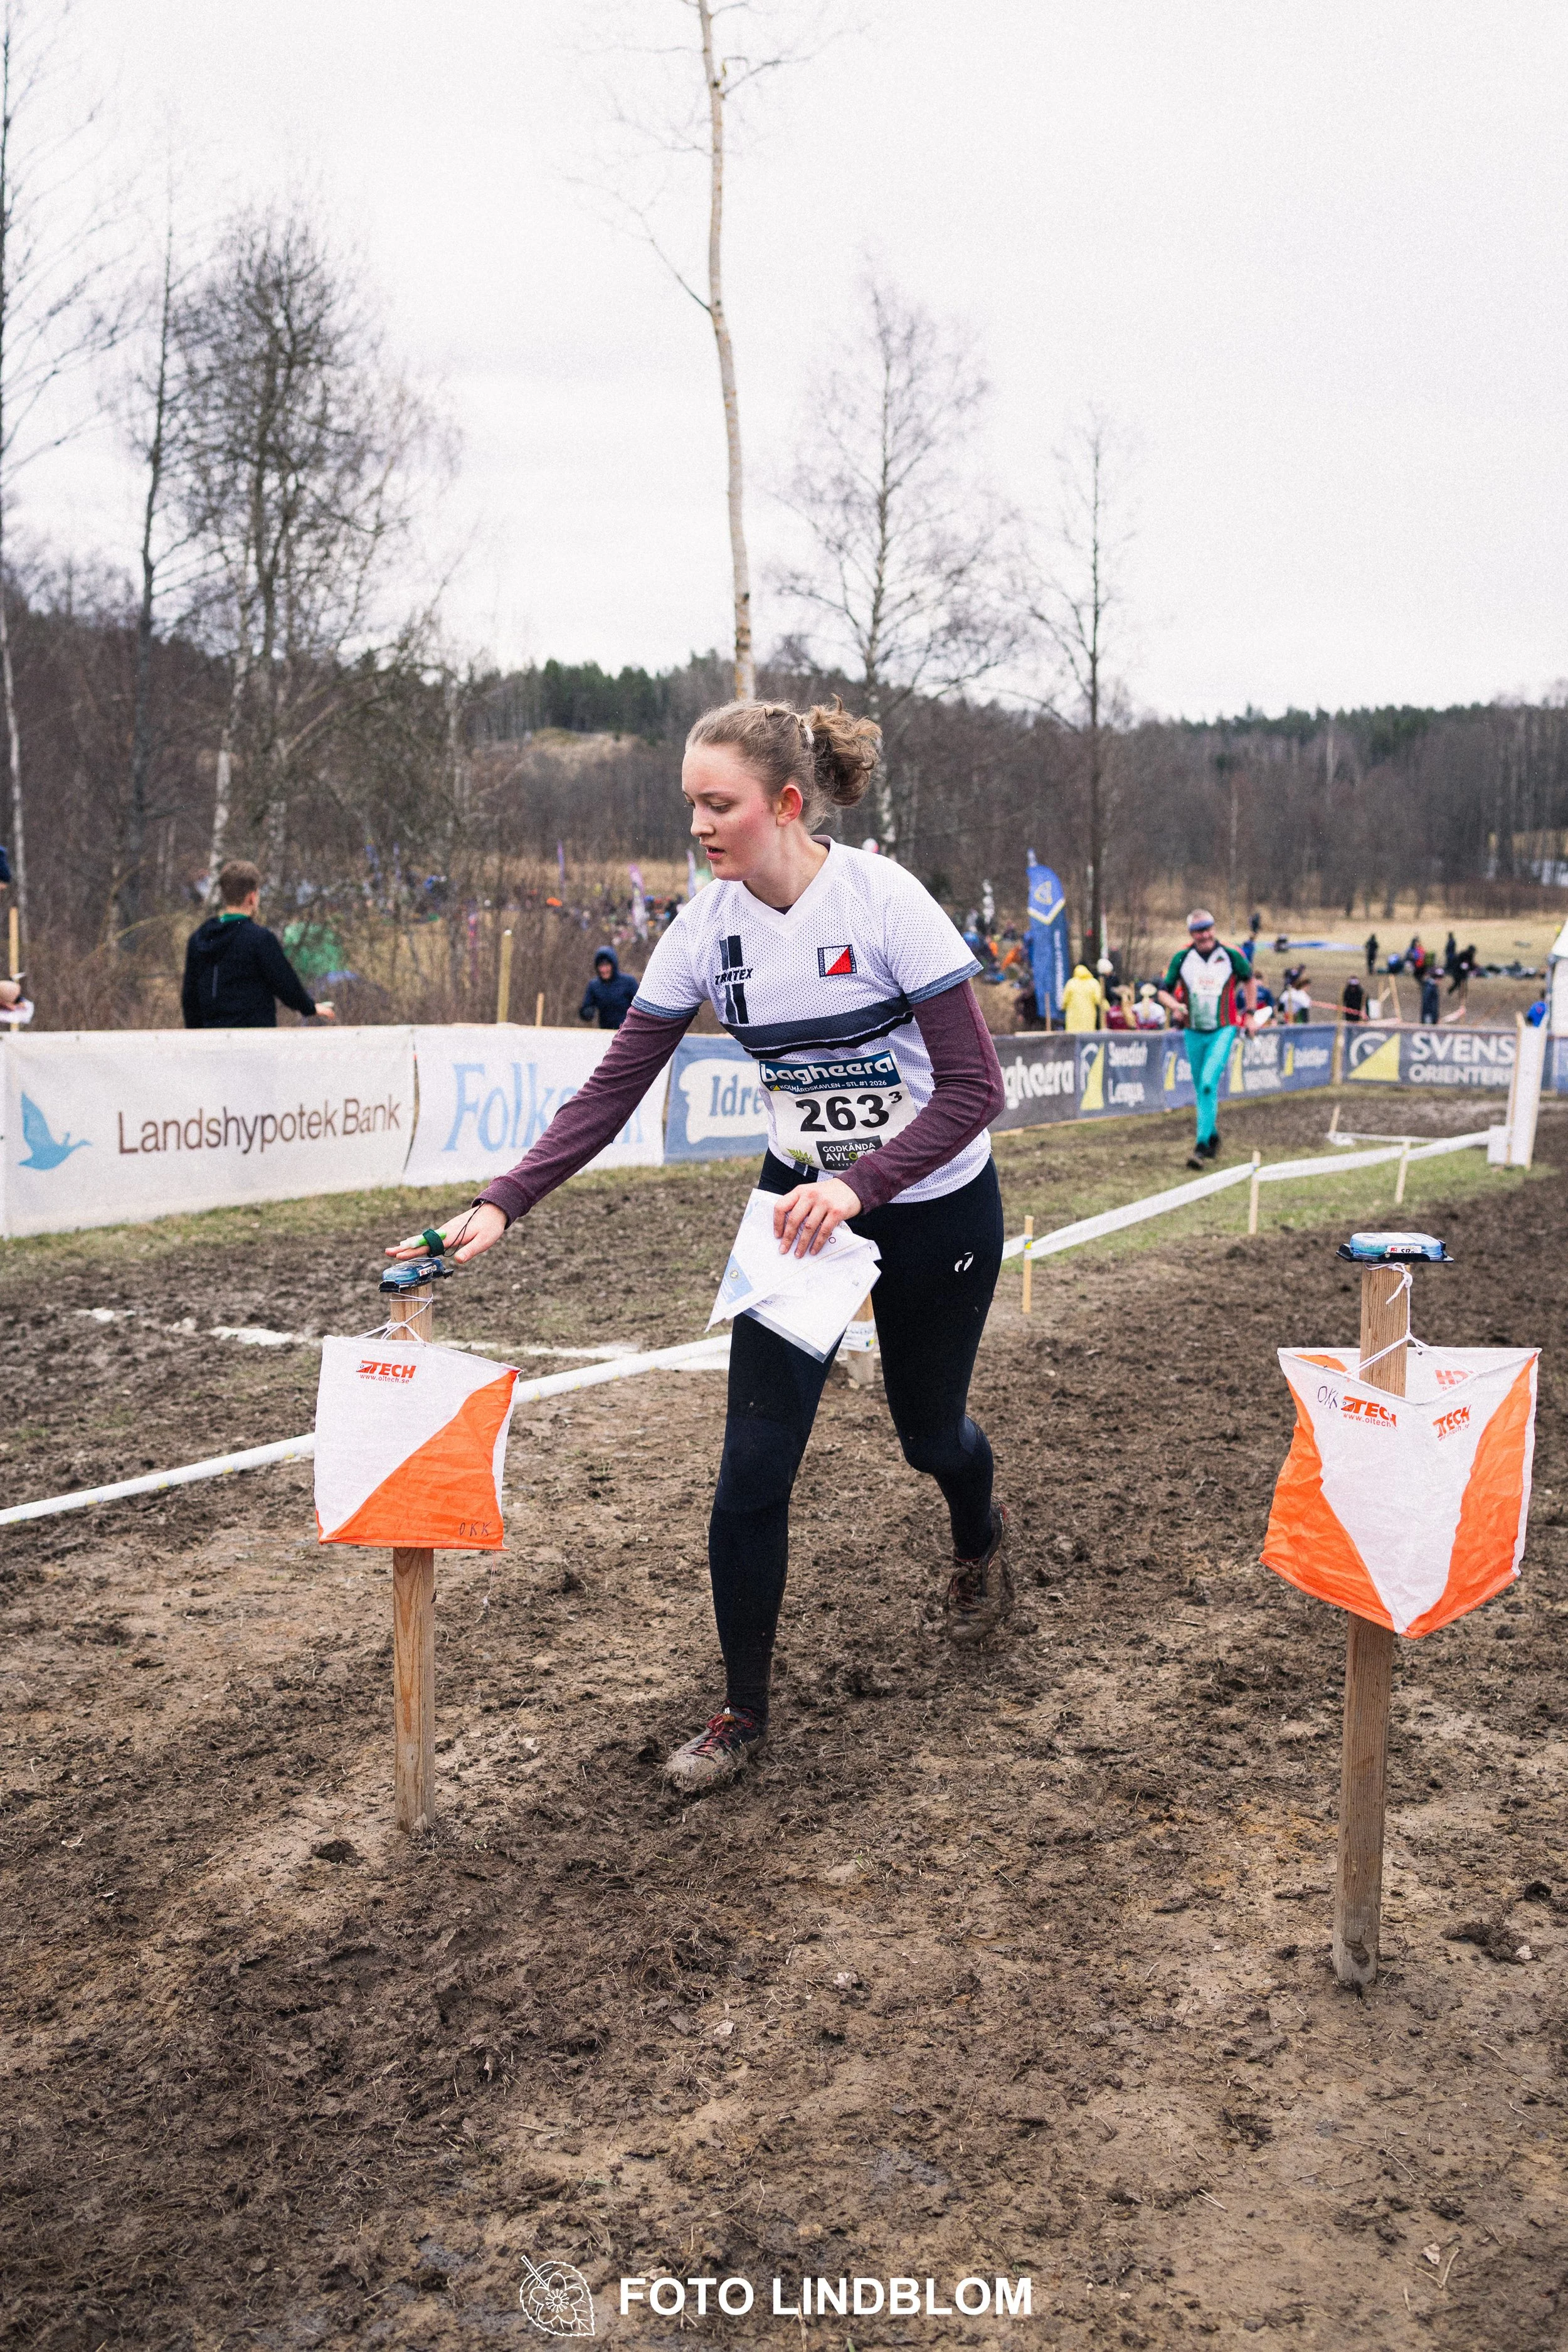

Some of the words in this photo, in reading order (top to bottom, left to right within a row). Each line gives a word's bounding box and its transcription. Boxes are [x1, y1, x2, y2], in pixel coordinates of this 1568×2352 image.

[760, 1056, 894, 1085] bagheera
[780, 1083, 841, 1093] KOLMÅRDSKAVLEN
[795, 1094, 890, 1132] 263
[888, 1091, 903, 1104] 3
[118, 1099, 337, 1155] Landshypotek
[342, 1094, 401, 1135] Bank
[822, 1142, 876, 1153] GODKÄNDA
[359, 1374, 410, 1384] www.oltech.se
